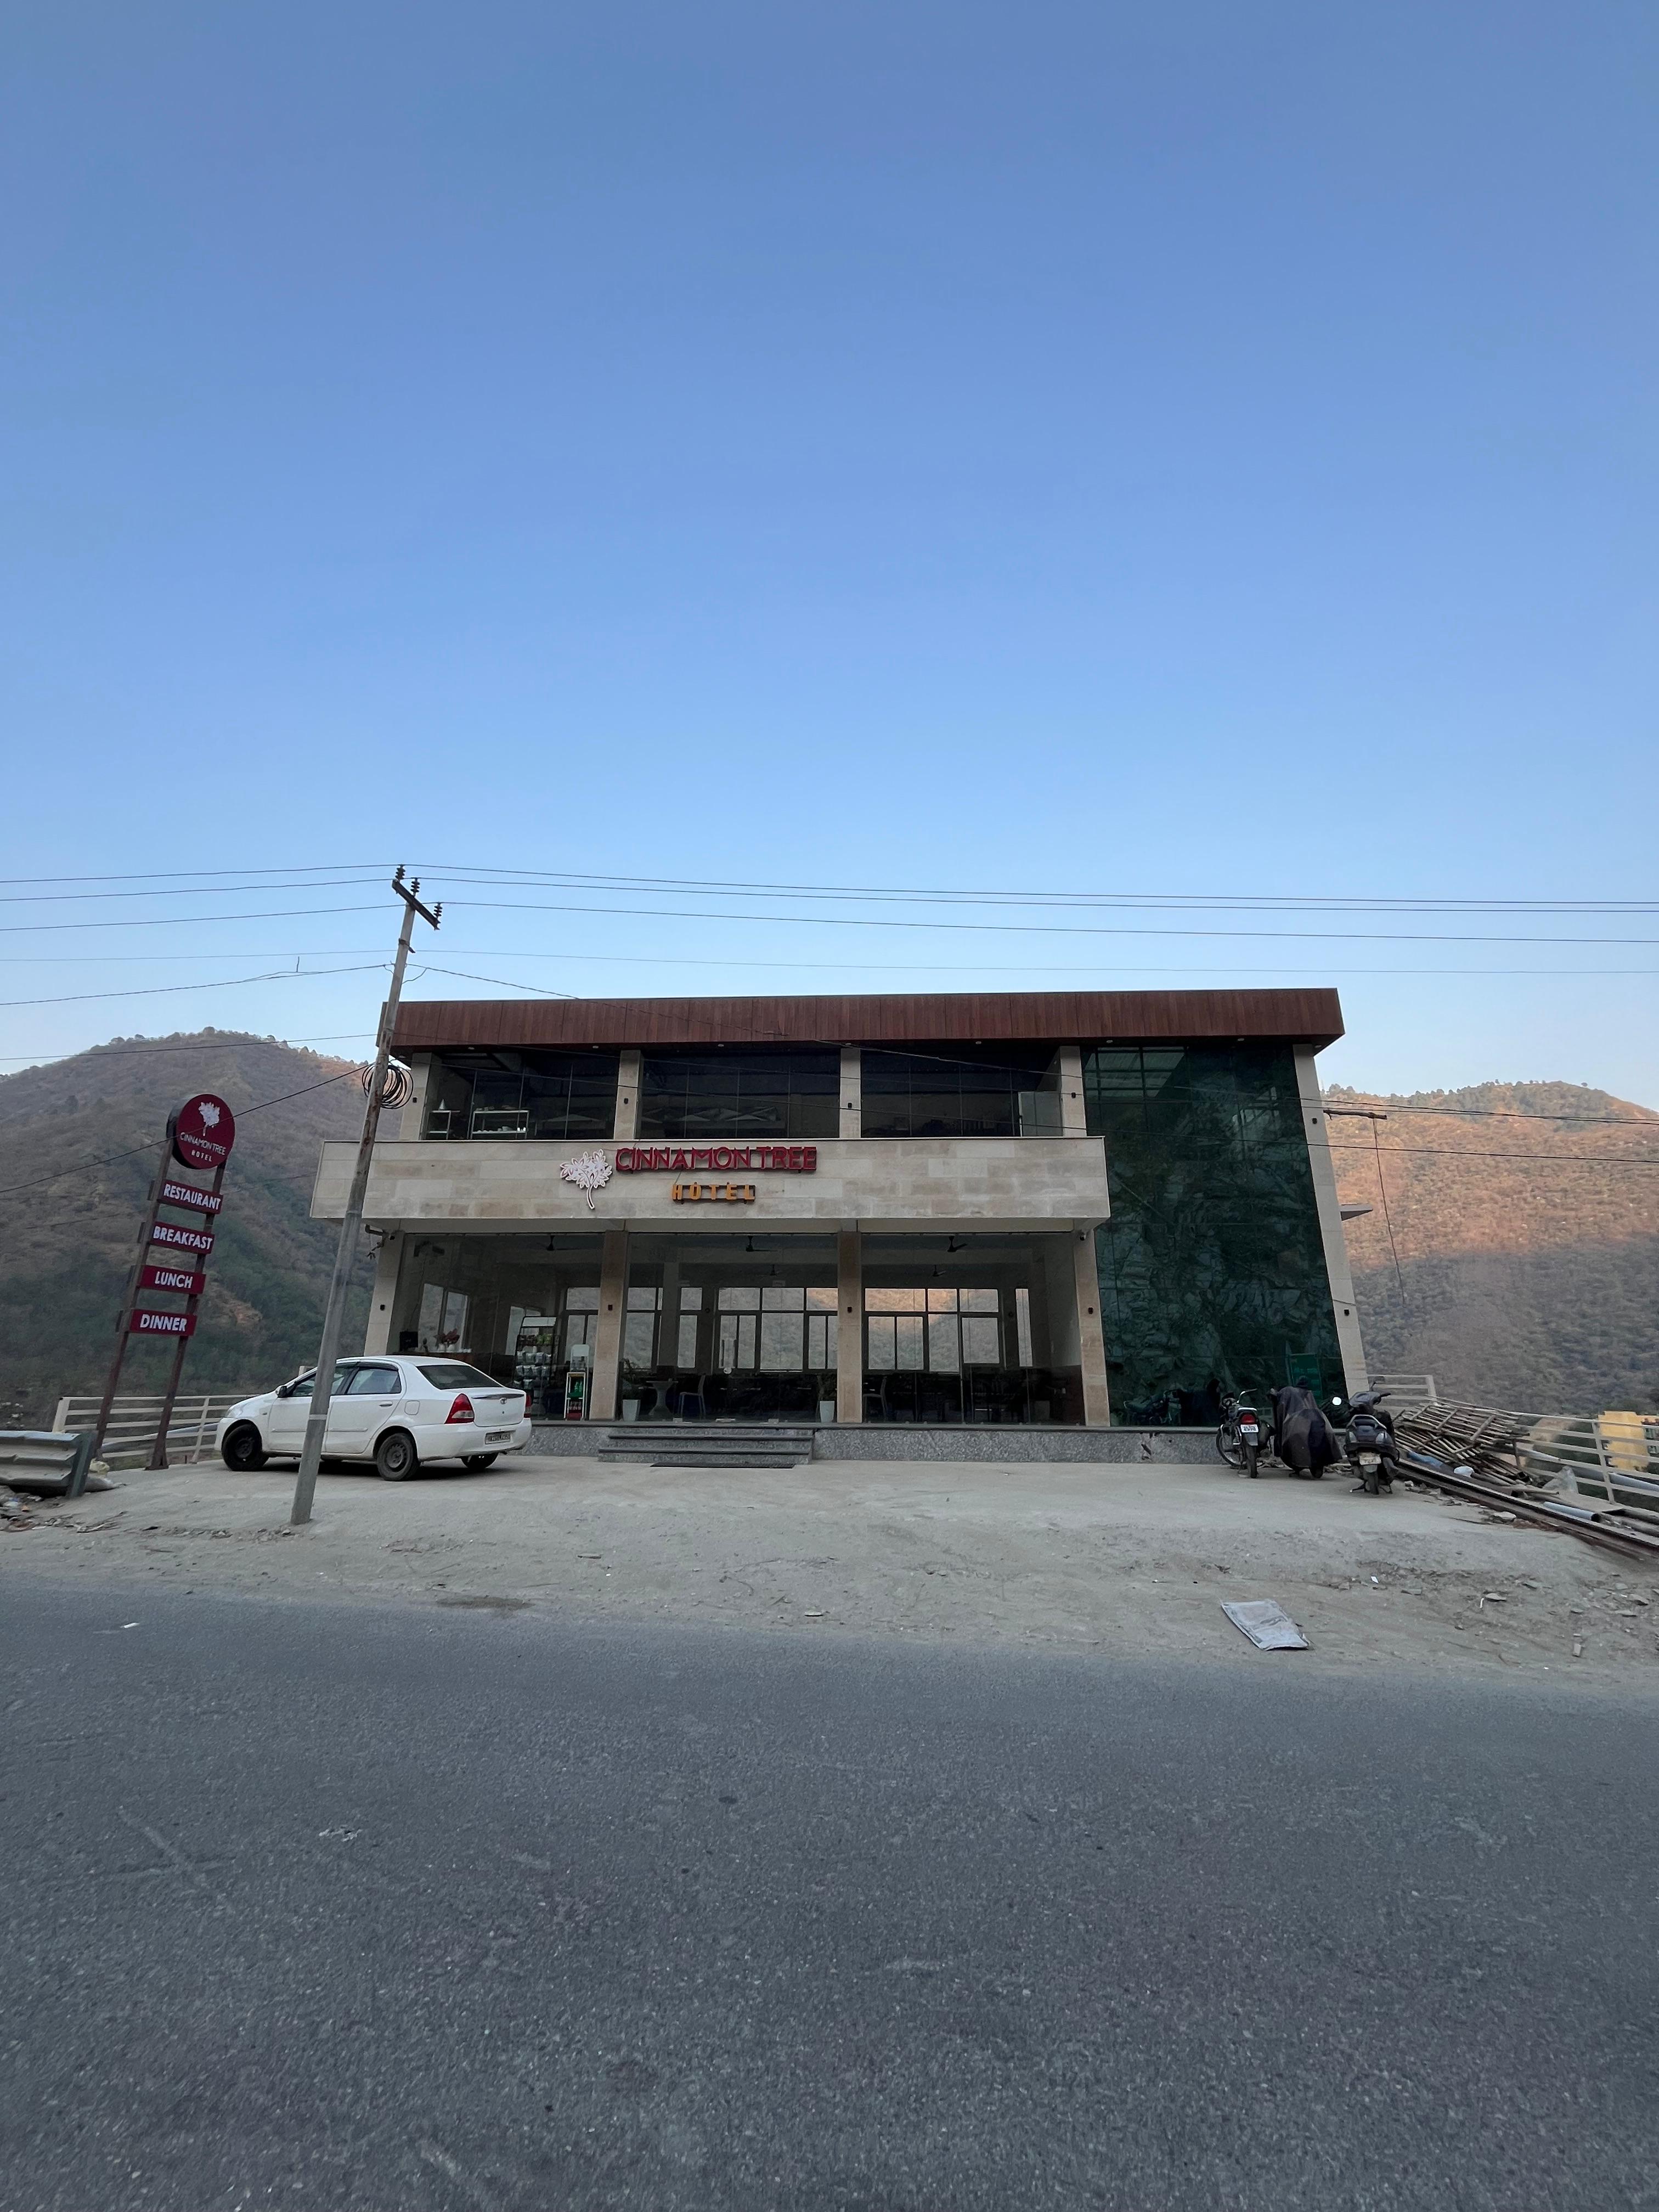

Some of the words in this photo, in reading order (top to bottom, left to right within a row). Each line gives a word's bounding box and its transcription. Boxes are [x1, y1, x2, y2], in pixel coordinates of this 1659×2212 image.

[191, 1149, 212, 1162] HOTEL
[616, 1147, 750, 1170] CINNAMON
[756, 1146, 817, 1170] TREE
[163, 1184, 221, 1211] RESTAURANT
[672, 1183, 756, 1200] HOTEL
[153, 1226, 213, 1250] BREAKFAST
[155, 1271, 193, 1289] LUNCH
[140, 1314, 188, 1332] DINNER
